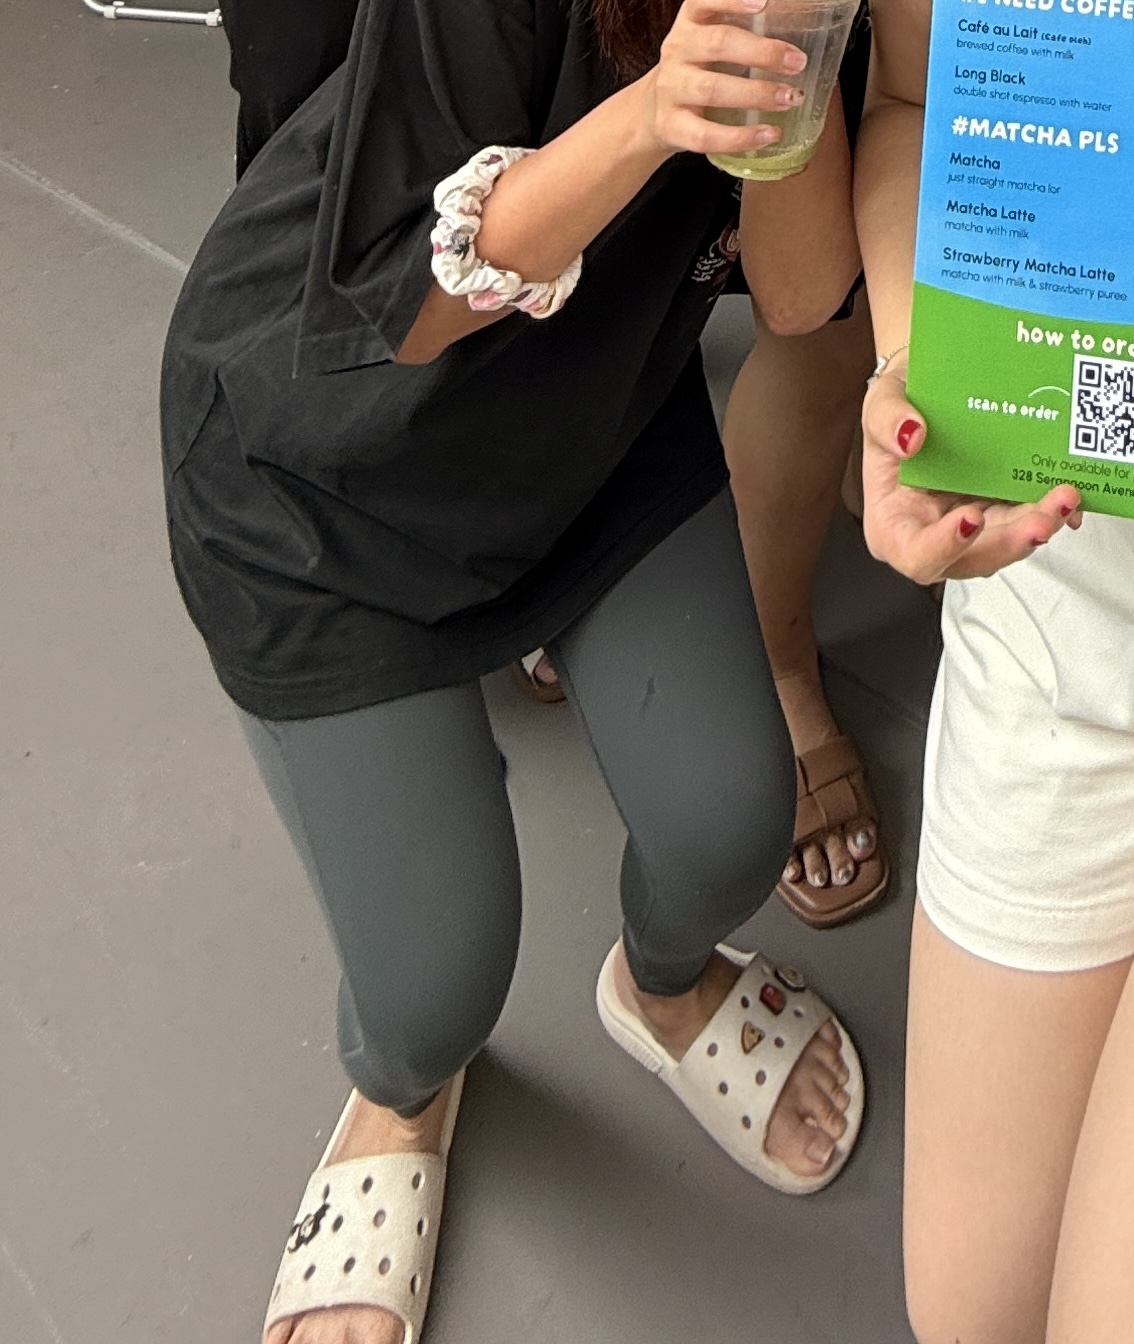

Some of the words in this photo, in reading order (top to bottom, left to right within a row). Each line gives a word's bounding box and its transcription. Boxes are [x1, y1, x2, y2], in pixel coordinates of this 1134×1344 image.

[958, 18, 990, 33] Café
[993, 25, 1010, 36] au
[1014, 25, 1039, 40] Lait
[956, 37, 994, 51] brewed
[996, 43, 1028, 56] coffee
[1031, 47, 1052, 58] with
[1054, 49, 1074, 60] milk
[955, 65, 986, 84] Long
[991, 69, 1026, 85] Black
[953, 85, 987, 98] double
[989, 89, 1010, 101] shot
[1013, 94, 1056, 106] espresso
[1059, 98, 1080, 109] with
[1083, 101, 1112, 112] water
[952, 115, 1072, 147] #MATCHA
[1078, 130, 1119, 154] PLS
[949, 152, 1001, 170] Matcha
[946, 173, 965, 185] just
[967, 175, 1005, 189] straight
[1007, 179, 1046, 193] matcha
[946, 200, 997, 218] Matcha
[1001, 206, 1036, 223] Latte
[944, 220, 983, 233] matcha
[986, 225, 1007, 237] with
[1009, 228, 1029, 239] milk
[943, 247, 1020, 273] Strawberry
[1024, 258, 1076, 277] Matcha
[1080, 265, 1116, 282] Latte
[941, 268, 980, 281] matcha
[982, 273, 1003, 285] with
[1006, 276, 1026, 288] milk
[1028, 279, 1037, 289] &
[1039, 280, 1095, 300] strawberry
[1097, 290, 1127, 301] puree
[1017, 320, 1064, 347] how
[1071, 330, 1095, 350] to
[967, 396, 998, 412] scan
[1002, 401, 1017, 414] to
[1020, 404, 1059, 421] order
[1012, 468, 1033, 482] 328
[1032, 454, 1057, 472] Only
[1060, 460, 1111, 477] available
[1114, 467, 1129, 480] for
